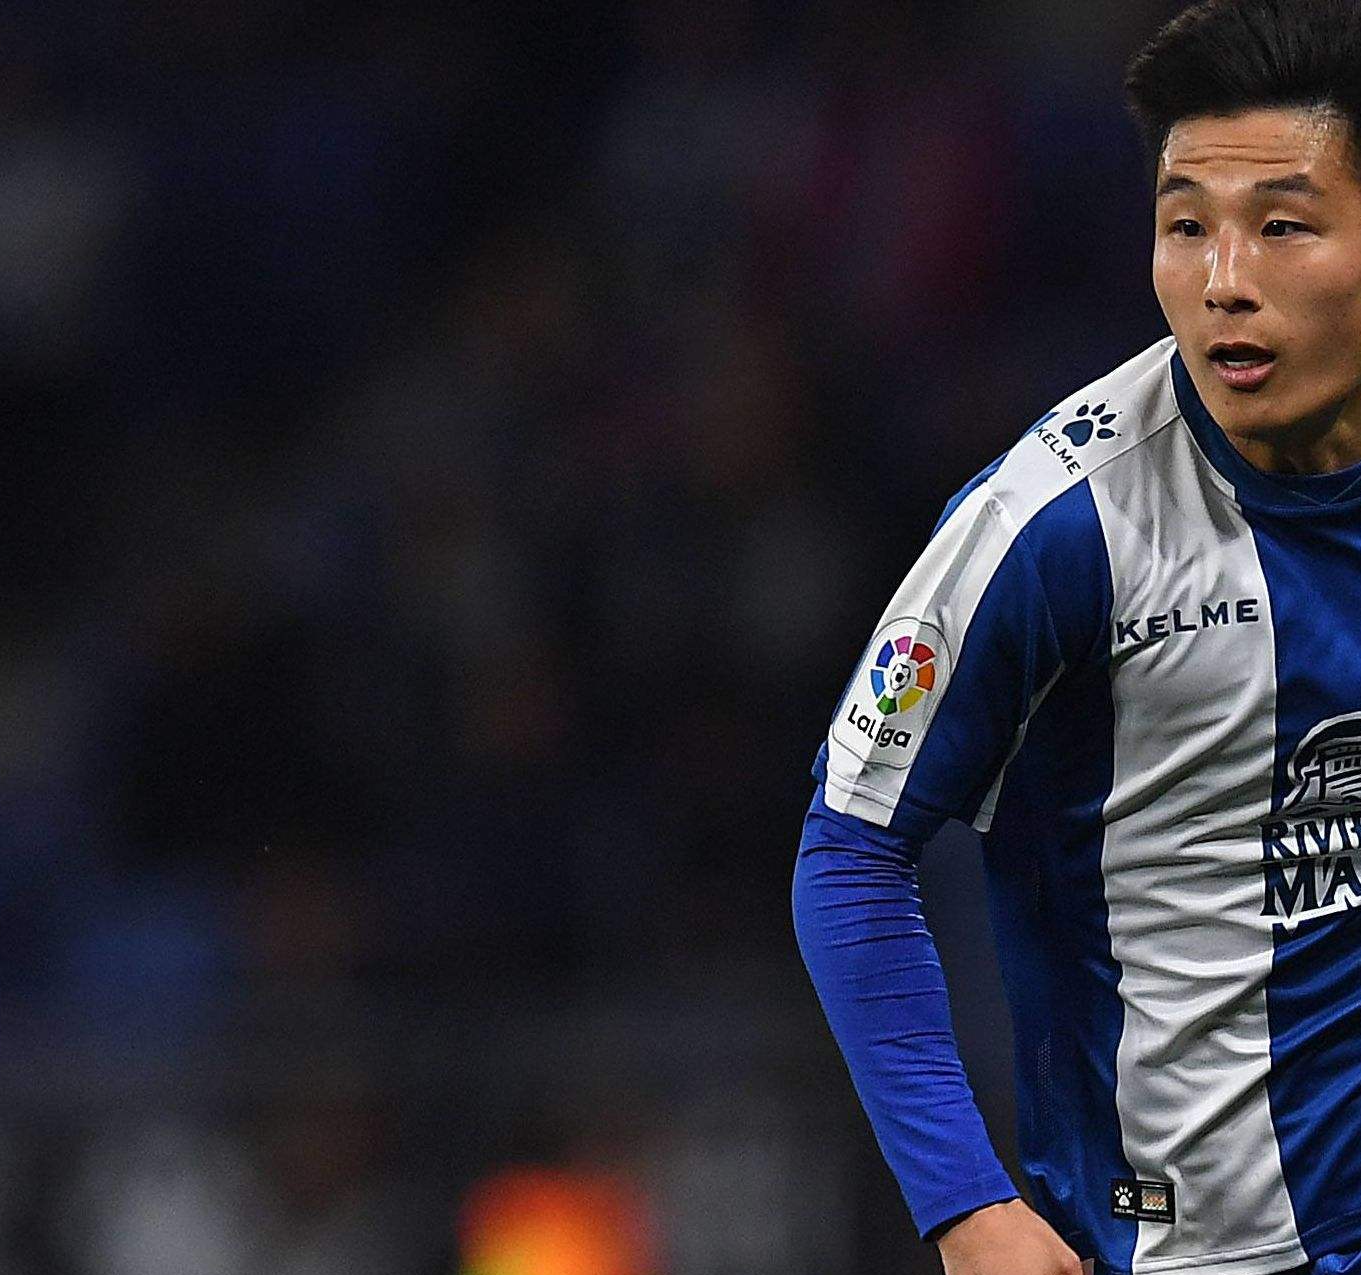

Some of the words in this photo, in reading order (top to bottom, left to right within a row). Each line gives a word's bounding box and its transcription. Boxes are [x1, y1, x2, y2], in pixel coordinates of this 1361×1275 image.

[1034, 426, 1082, 475] KELME
[1115, 598, 1259, 644] KELME
[847, 703, 912, 748] LaLiga
